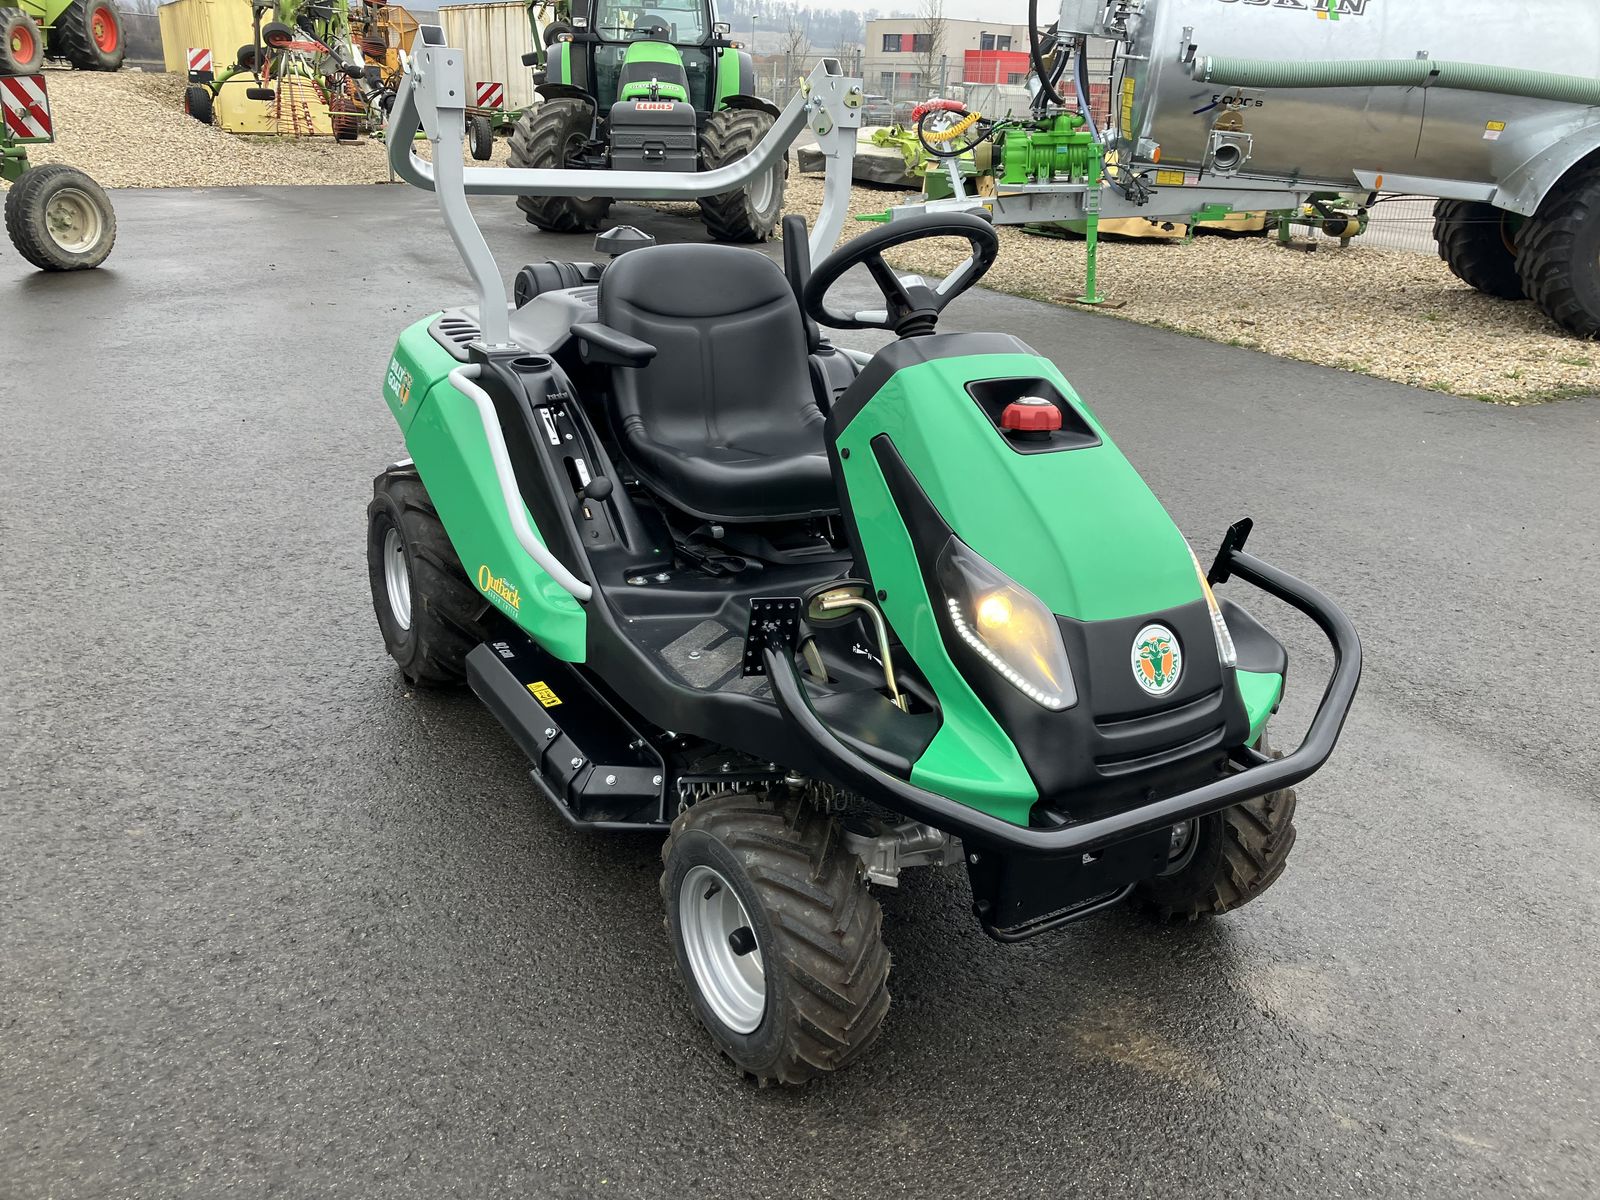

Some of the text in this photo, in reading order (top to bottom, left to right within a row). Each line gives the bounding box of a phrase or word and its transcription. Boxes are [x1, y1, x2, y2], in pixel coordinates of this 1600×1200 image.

[636, 102, 674, 110] CLAAS
[478, 564, 521, 610] Outback
[1135, 653, 1178, 688] BILLY GOAT
